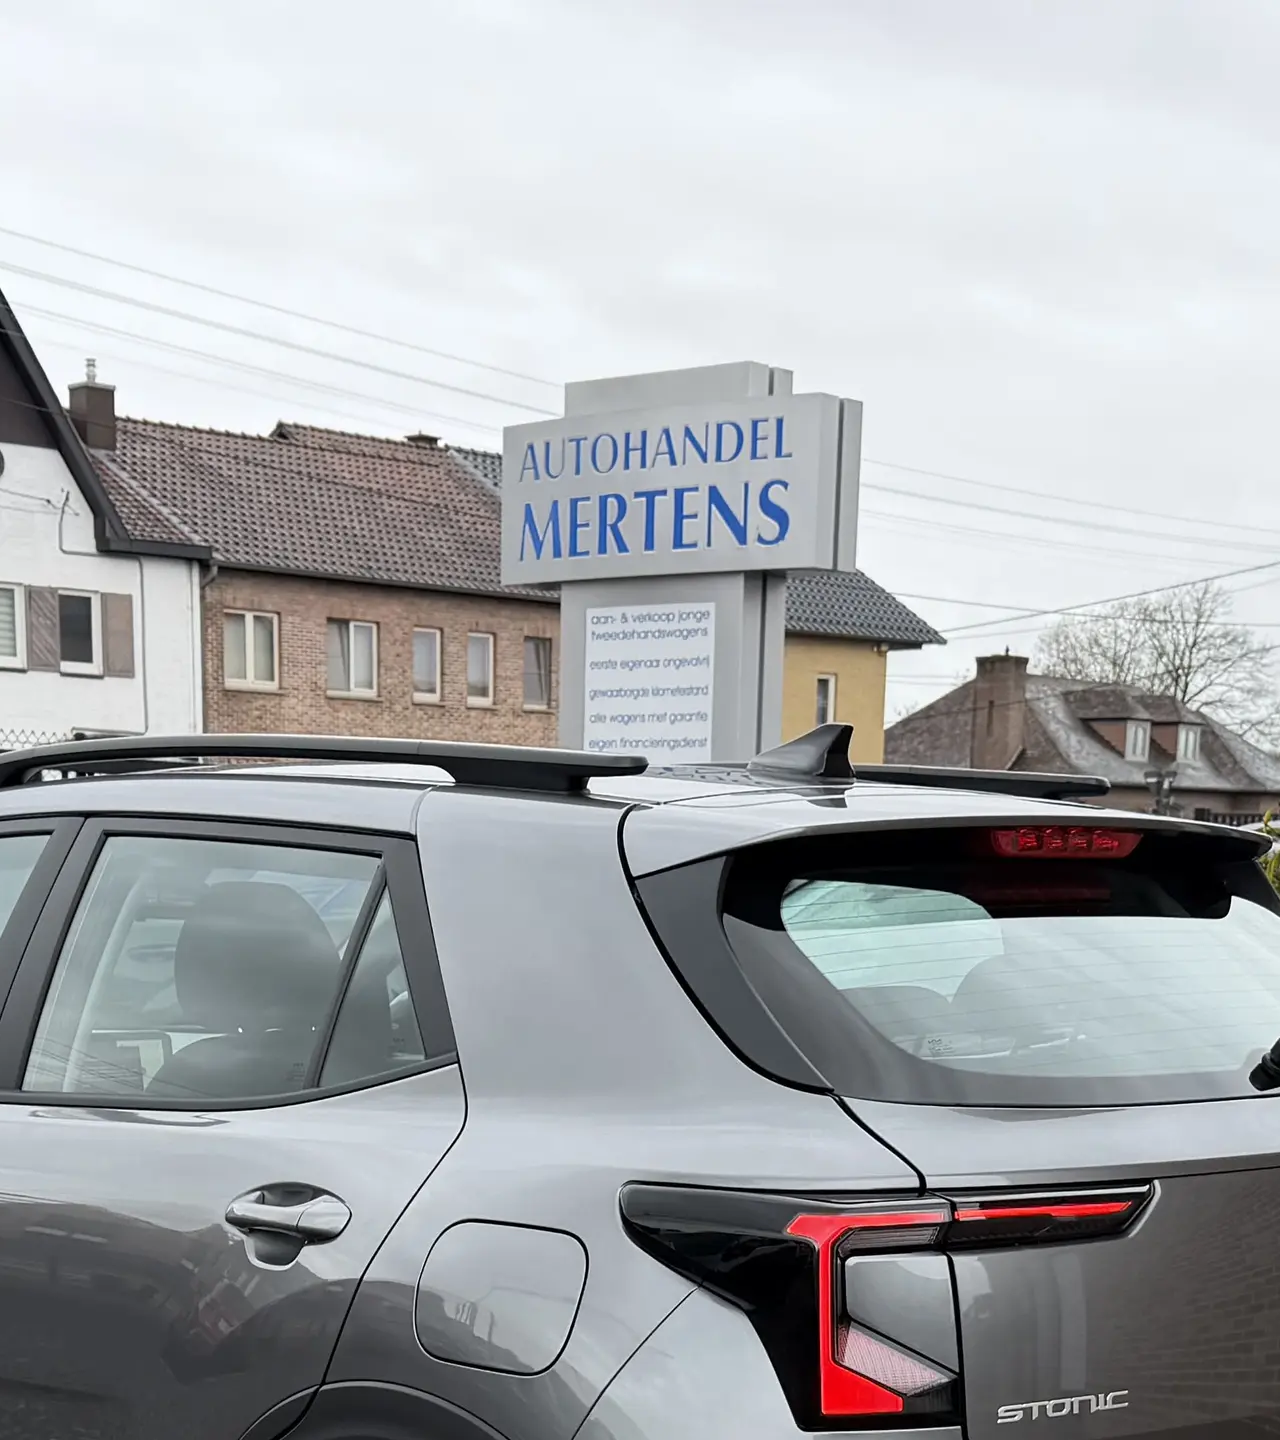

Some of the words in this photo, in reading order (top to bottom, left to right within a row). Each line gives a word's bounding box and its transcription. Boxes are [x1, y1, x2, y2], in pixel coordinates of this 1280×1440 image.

[519, 415, 793, 483] AUTOHANDEL
[519, 479, 791, 562] MERTENS
[677, 609, 710, 623] jonge
[997, 1389, 1129, 1424] STONIC
